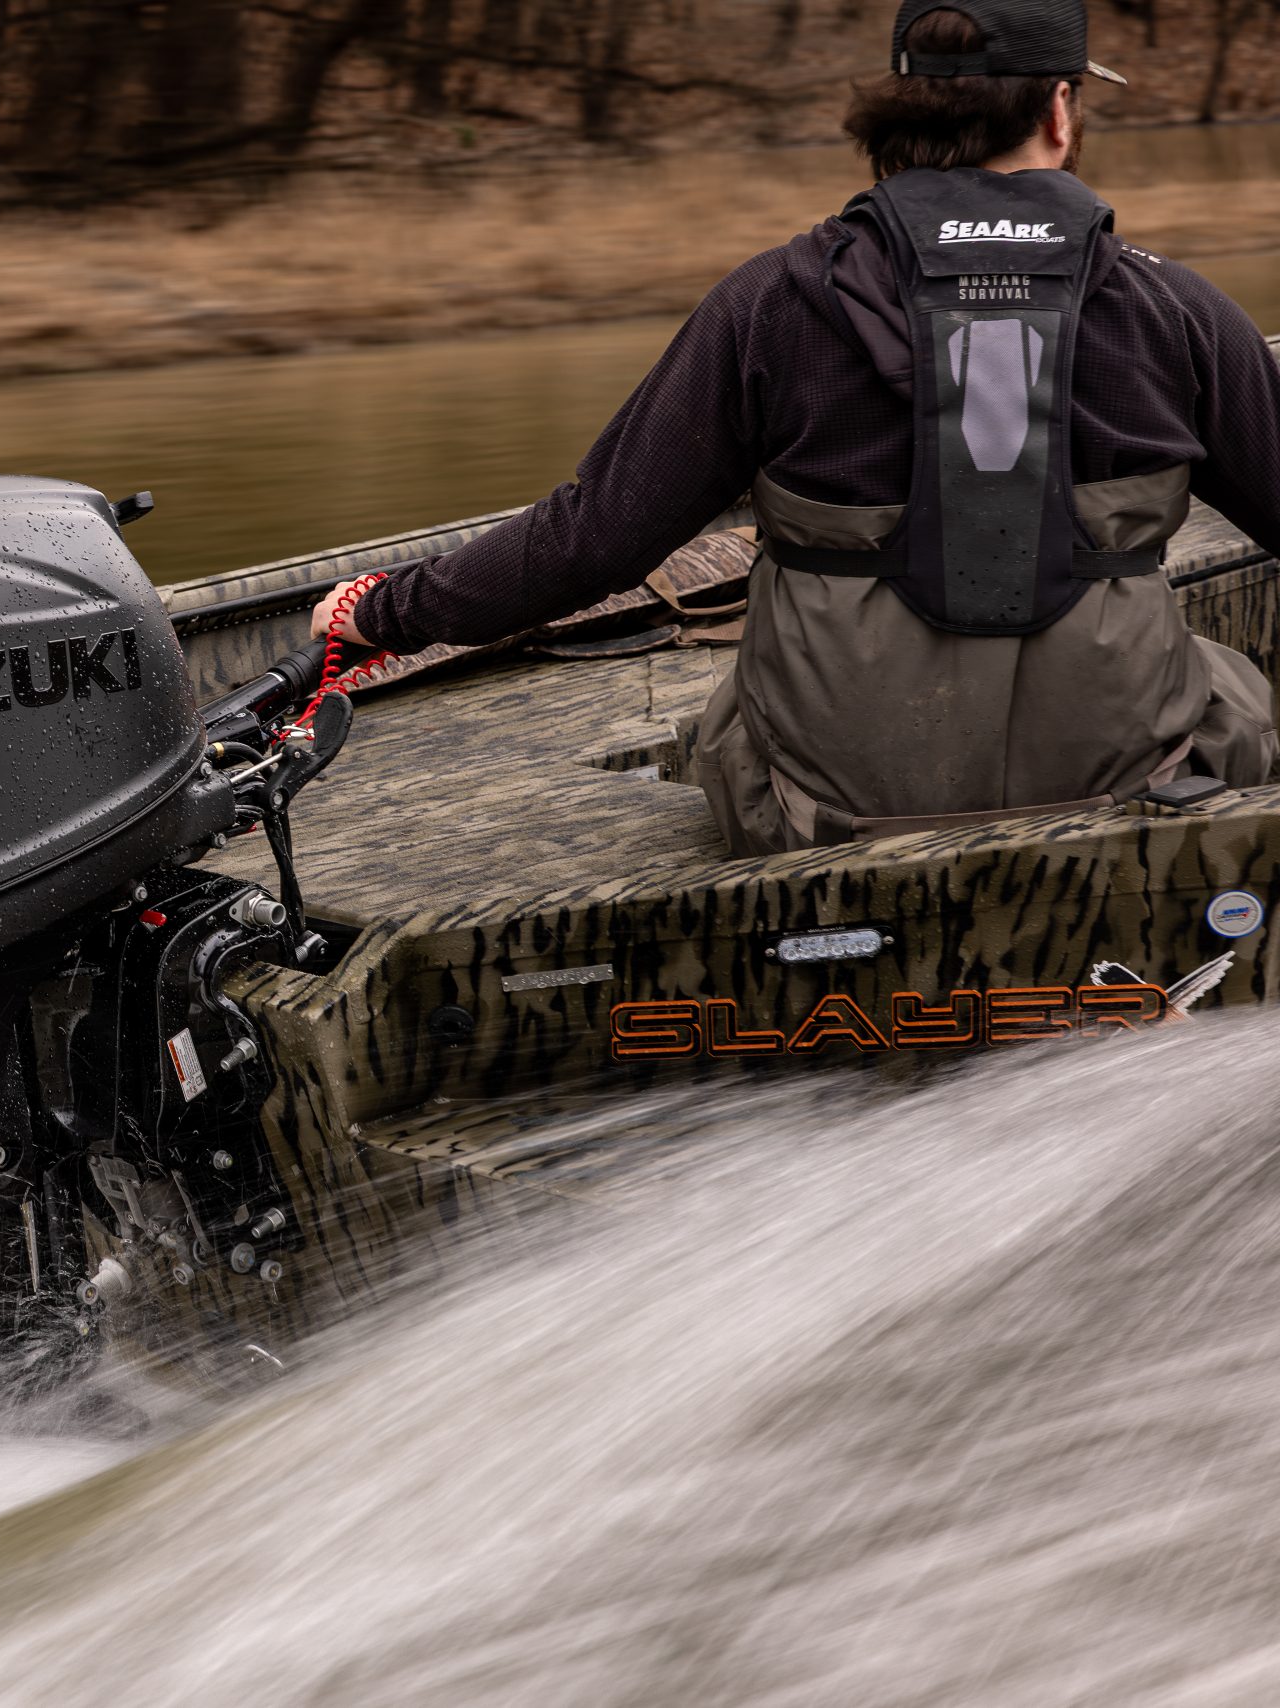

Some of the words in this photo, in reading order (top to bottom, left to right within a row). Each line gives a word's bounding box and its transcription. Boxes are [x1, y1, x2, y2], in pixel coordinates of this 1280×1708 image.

[959, 275, 1030, 286] MUSTANG
[959, 288, 1031, 300] SURVIVAL
[610, 983, 1169, 1061] SLAYER
